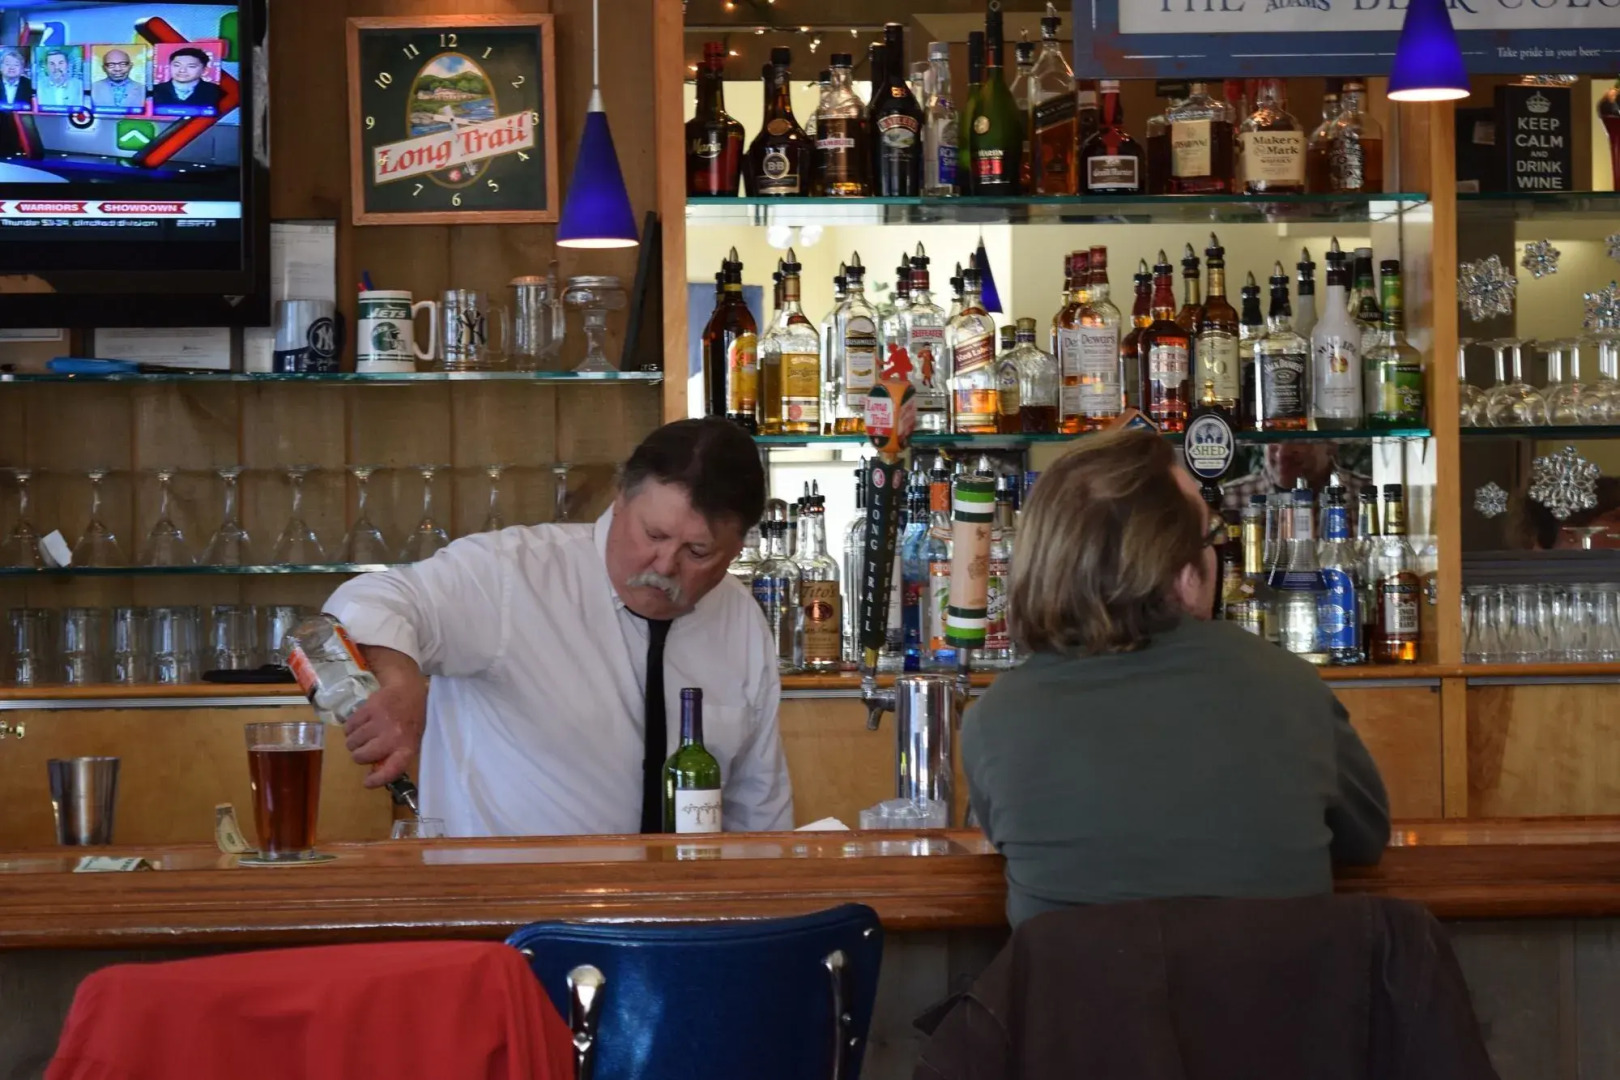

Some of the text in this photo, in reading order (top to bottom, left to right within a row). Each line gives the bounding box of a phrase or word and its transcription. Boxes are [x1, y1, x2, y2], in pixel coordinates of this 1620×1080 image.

[440, 34, 458, 47] 12
[403, 44, 420, 59] 11
[482, 47, 492, 59] 1
[1497, 47, 1518, 57] Take
[1520, 46, 1544, 60] pride
[1545, 47, 1555, 57] in
[1557, 49, 1577, 60] your
[375, 72, 393, 89] 10
[512, 76, 525, 88] 2
[365, 116, 376, 130] 9
[531, 112, 540, 126] 3
[1517, 117, 1560, 130] KEEP
[379, 112, 530, 175] Long Trail
[1515, 134, 1563, 148] CALM
[517, 151, 530, 161] 4
[1266, 146, 1299, 155] Mark
[1531, 150, 1548, 158] AND
[1516, 160, 1562, 173] DRINK
[488, 179, 499, 192] 5
[1516, 176, 1563, 189] WINE
[412, 184, 424, 197] 7
[452, 193, 462, 206] 6
[20, 204, 79, 212] WARRIORS
[104, 204, 178, 212] SHOWDOWN
[176, 219, 217, 227] ESPN
[366, 305, 407, 318] JETS
[845, 338, 876, 346] BUSHMILLS
[1195, 445, 1227, 456] SHED
[864, 494, 881, 632] LONG TRAIL
[801, 585, 837, 599] Tito's
